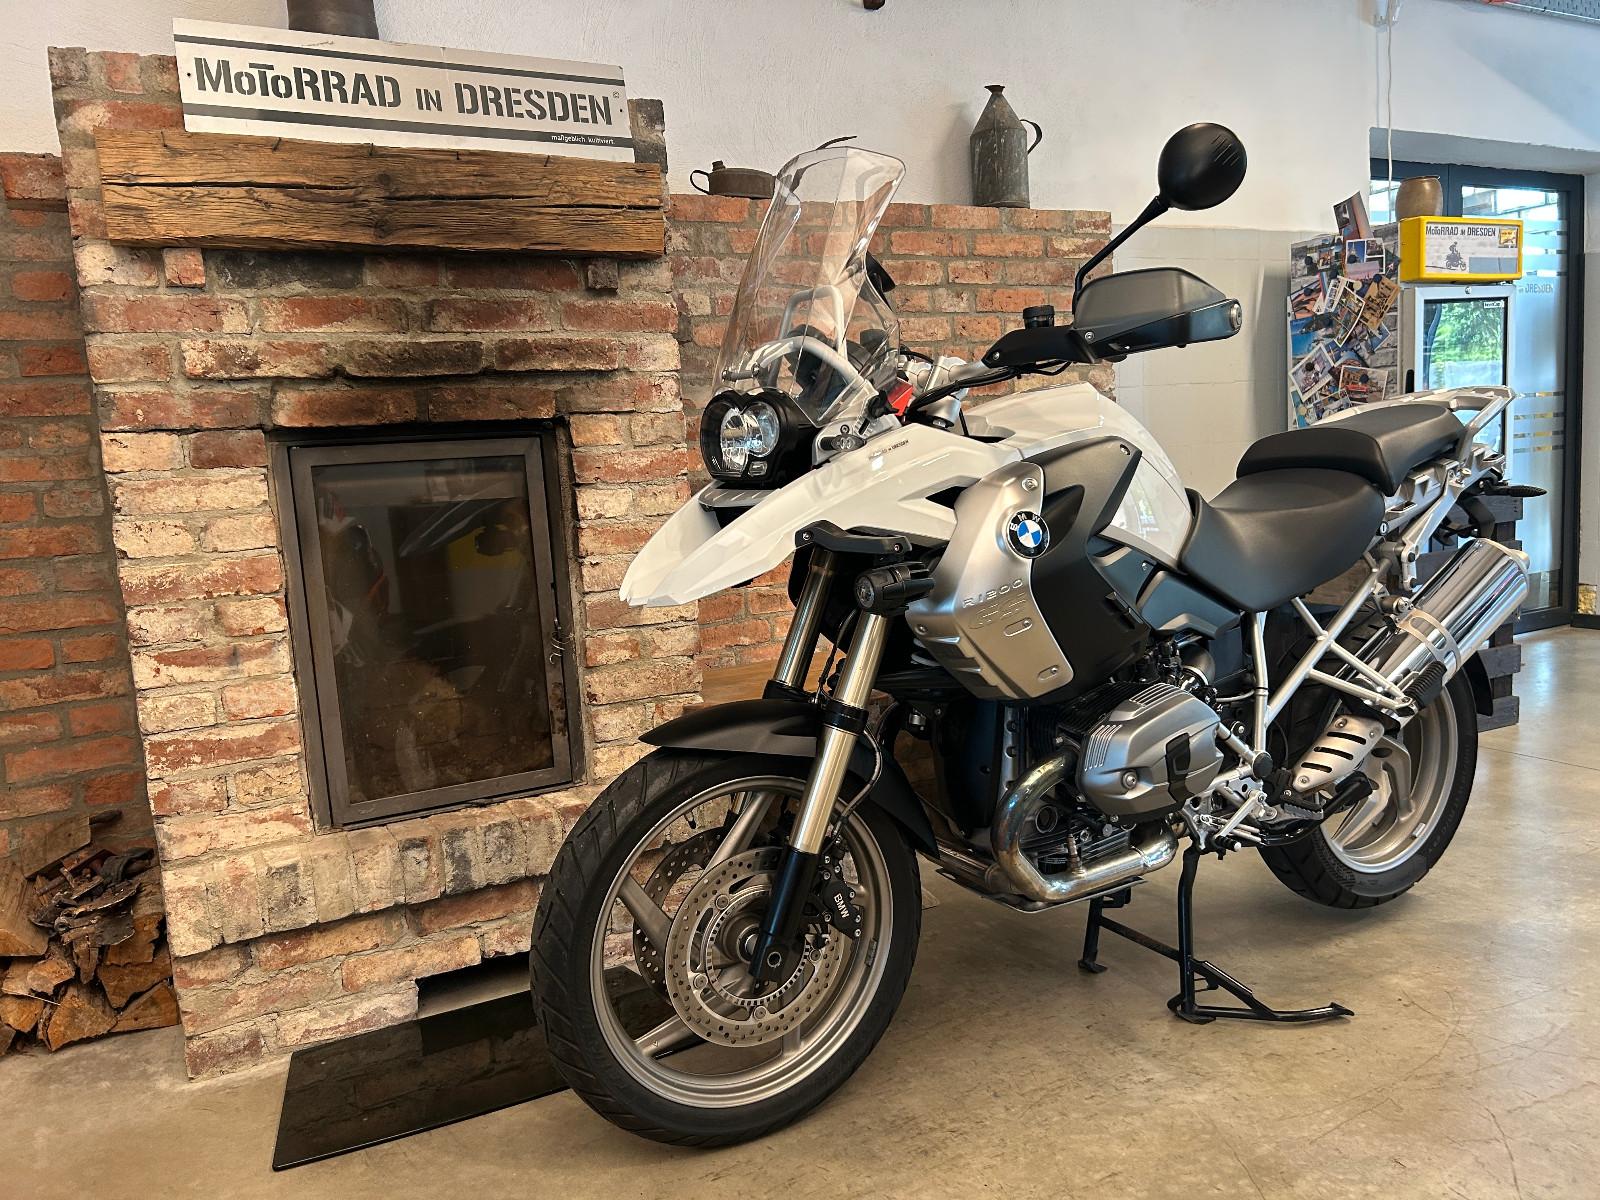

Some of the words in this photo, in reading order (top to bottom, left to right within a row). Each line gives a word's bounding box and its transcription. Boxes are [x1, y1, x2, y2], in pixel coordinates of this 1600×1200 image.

[416, 88, 443, 112] IN
[455, 82, 612, 126] DRESDEN
[1467, 227, 1496, 237] DRESDEN
[1010, 513, 1041, 532] BMW
[833, 893, 850, 919] BMW
